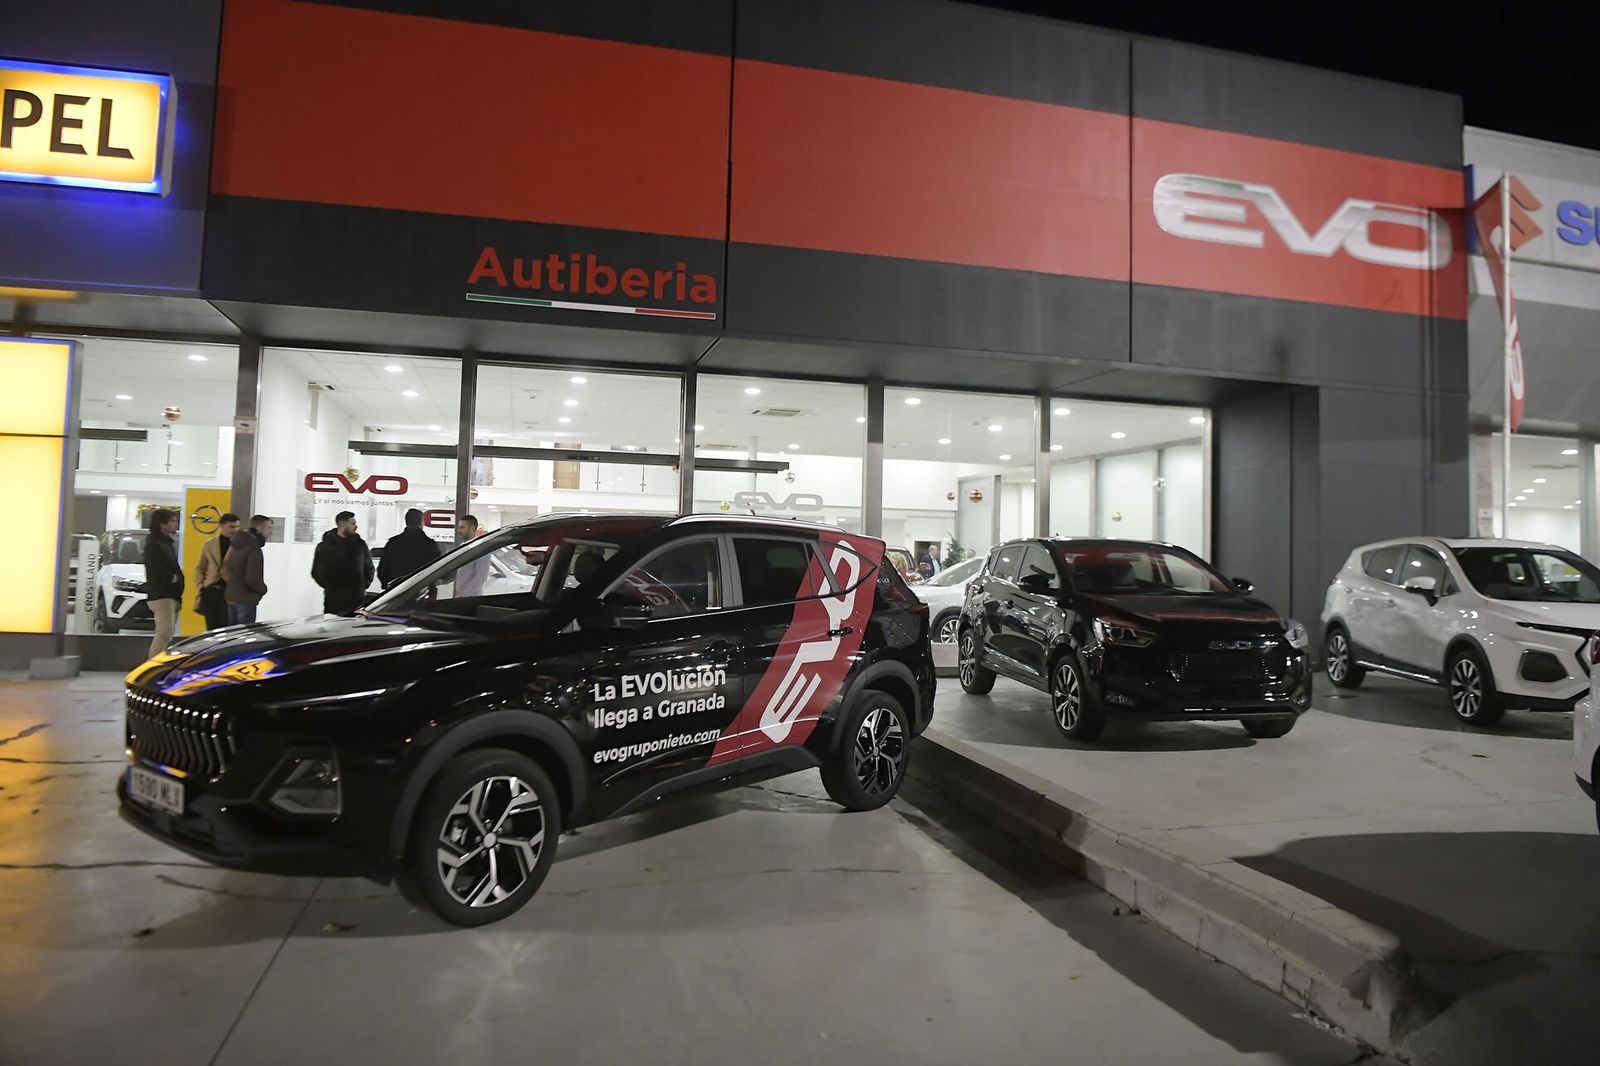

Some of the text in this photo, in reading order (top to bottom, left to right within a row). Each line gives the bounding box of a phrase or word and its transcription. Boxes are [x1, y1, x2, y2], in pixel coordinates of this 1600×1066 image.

[1153, 173, 1453, 270] EVO
[1557, 201, 1600, 247] S
[467, 246, 717, 303] Autiberia
[304, 473, 409, 495] EVO
[734, 491, 823, 512] EVO
[84, 553, 96, 612] CROSSLAND
[759, 540, 861, 743] EVO
[594, 668, 726, 702] La EVOlución
[594, 693, 725, 729] llega a Granada
[593, 728, 721, 764] evogruponieto.com
